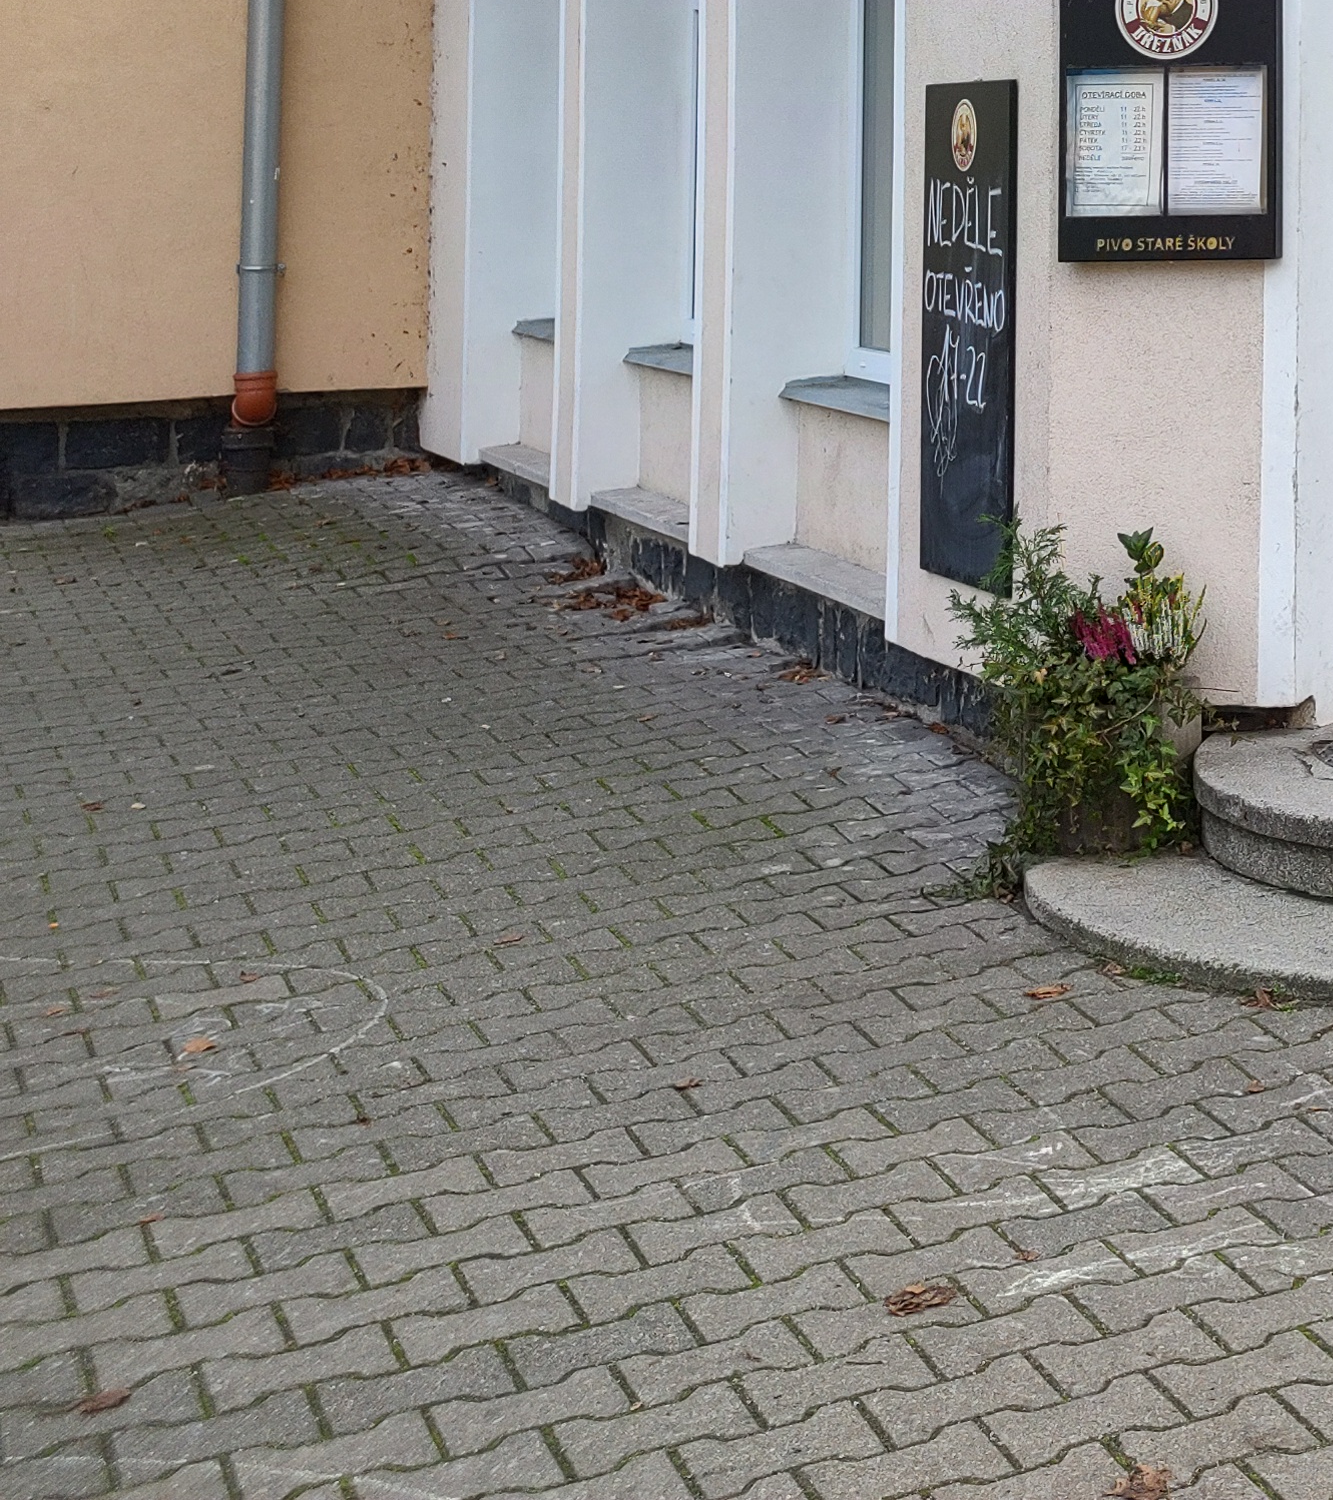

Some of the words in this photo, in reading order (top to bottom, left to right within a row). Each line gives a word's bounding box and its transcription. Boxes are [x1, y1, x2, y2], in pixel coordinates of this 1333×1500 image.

[925, 177, 1003, 257] NEDĚLE
[1096, 237, 1133, 251] PIVO
[1137, 234, 1183, 251] STARÉ
[1187, 232, 1236, 250] ŠKOLY
[925, 266, 1004, 332] OTEVŘENO
